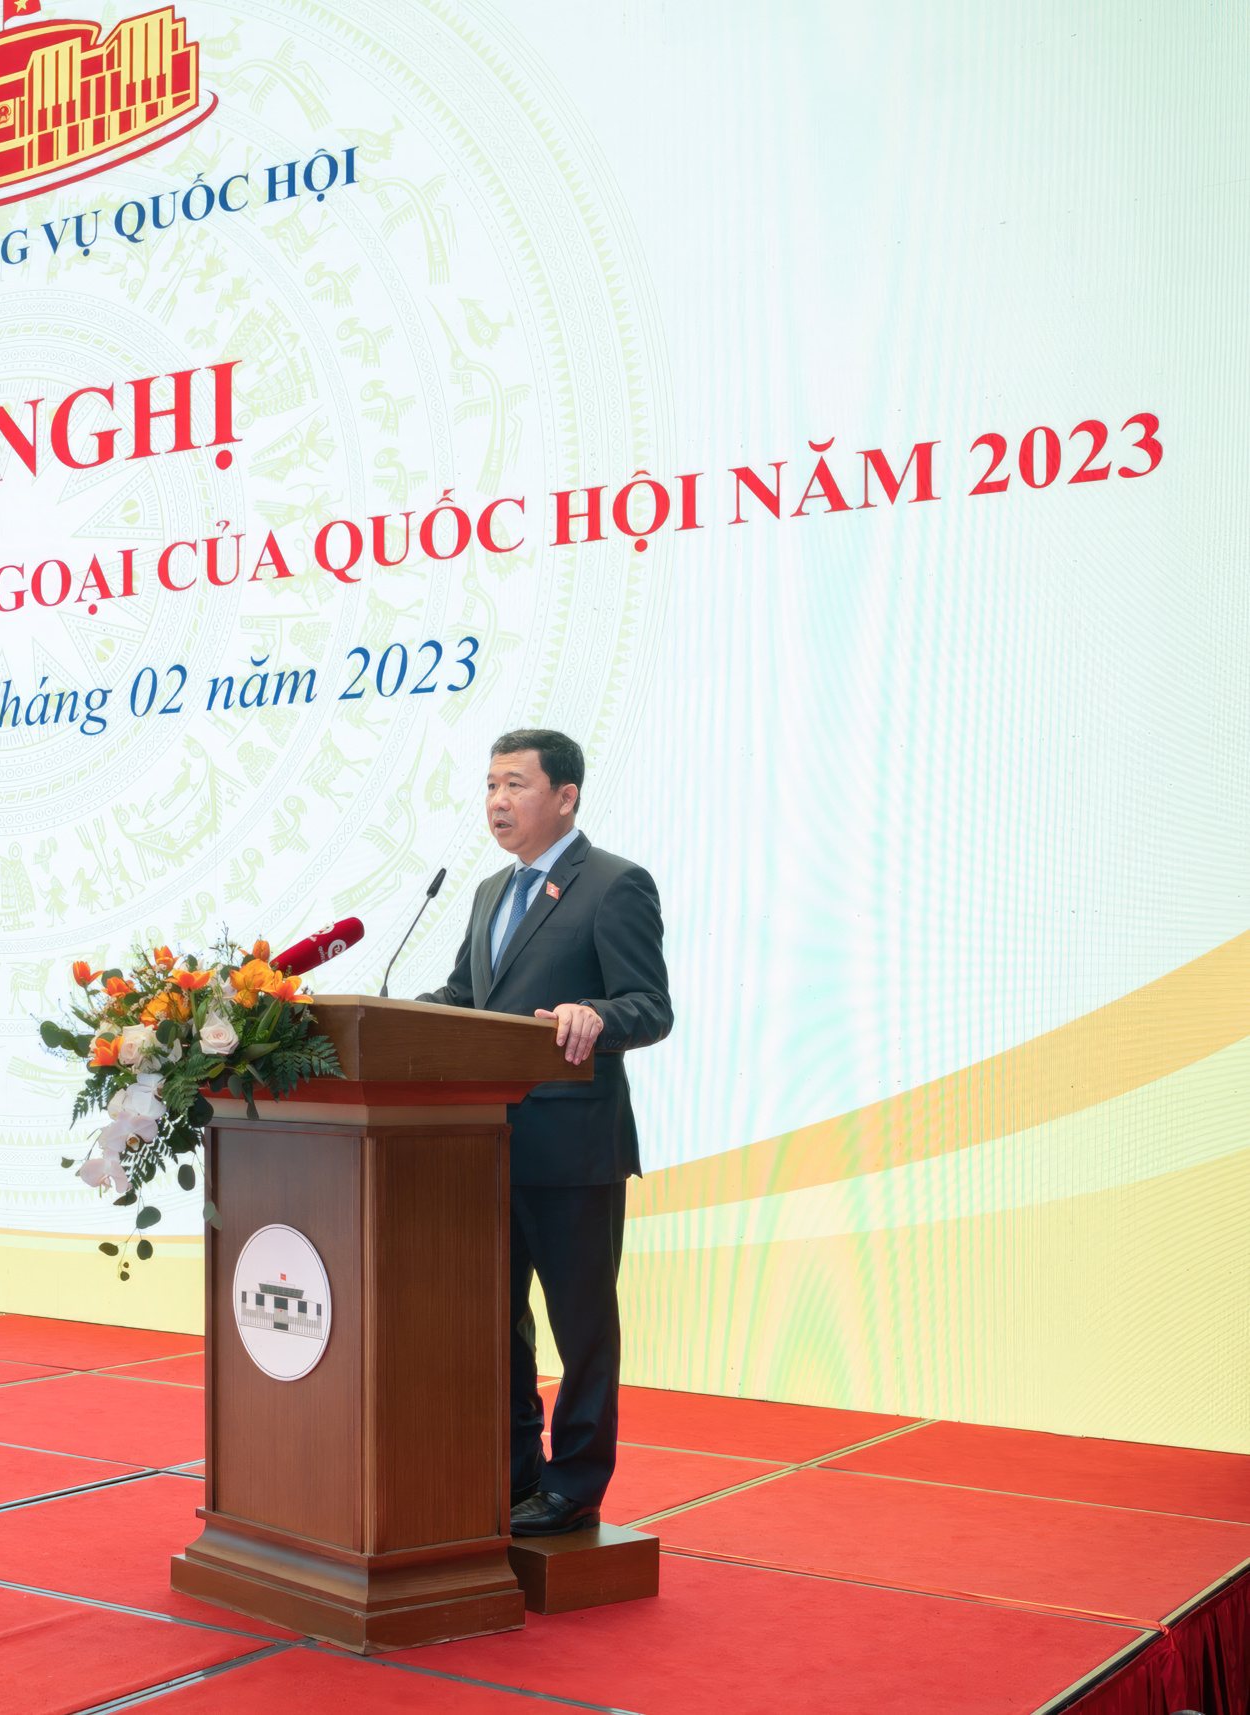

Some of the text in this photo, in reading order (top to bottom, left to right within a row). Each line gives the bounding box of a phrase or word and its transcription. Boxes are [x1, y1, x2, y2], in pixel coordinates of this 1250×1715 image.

[40, 209, 103, 257] VỤ
[114, 171, 249, 243] QUỐC
[263, 145, 360, 204] HỘI
[156, 519, 295, 593] CỦA
[313, 488, 525, 584] QUỐC
[549, 469, 704, 553] HỘI
[727, 437, 941, 525] NĂM
[968, 412, 1164, 497] 2023
[129, 663, 188, 718] 02
[205, 655, 318, 711] năm
[337, 636, 480, 701] 2023
